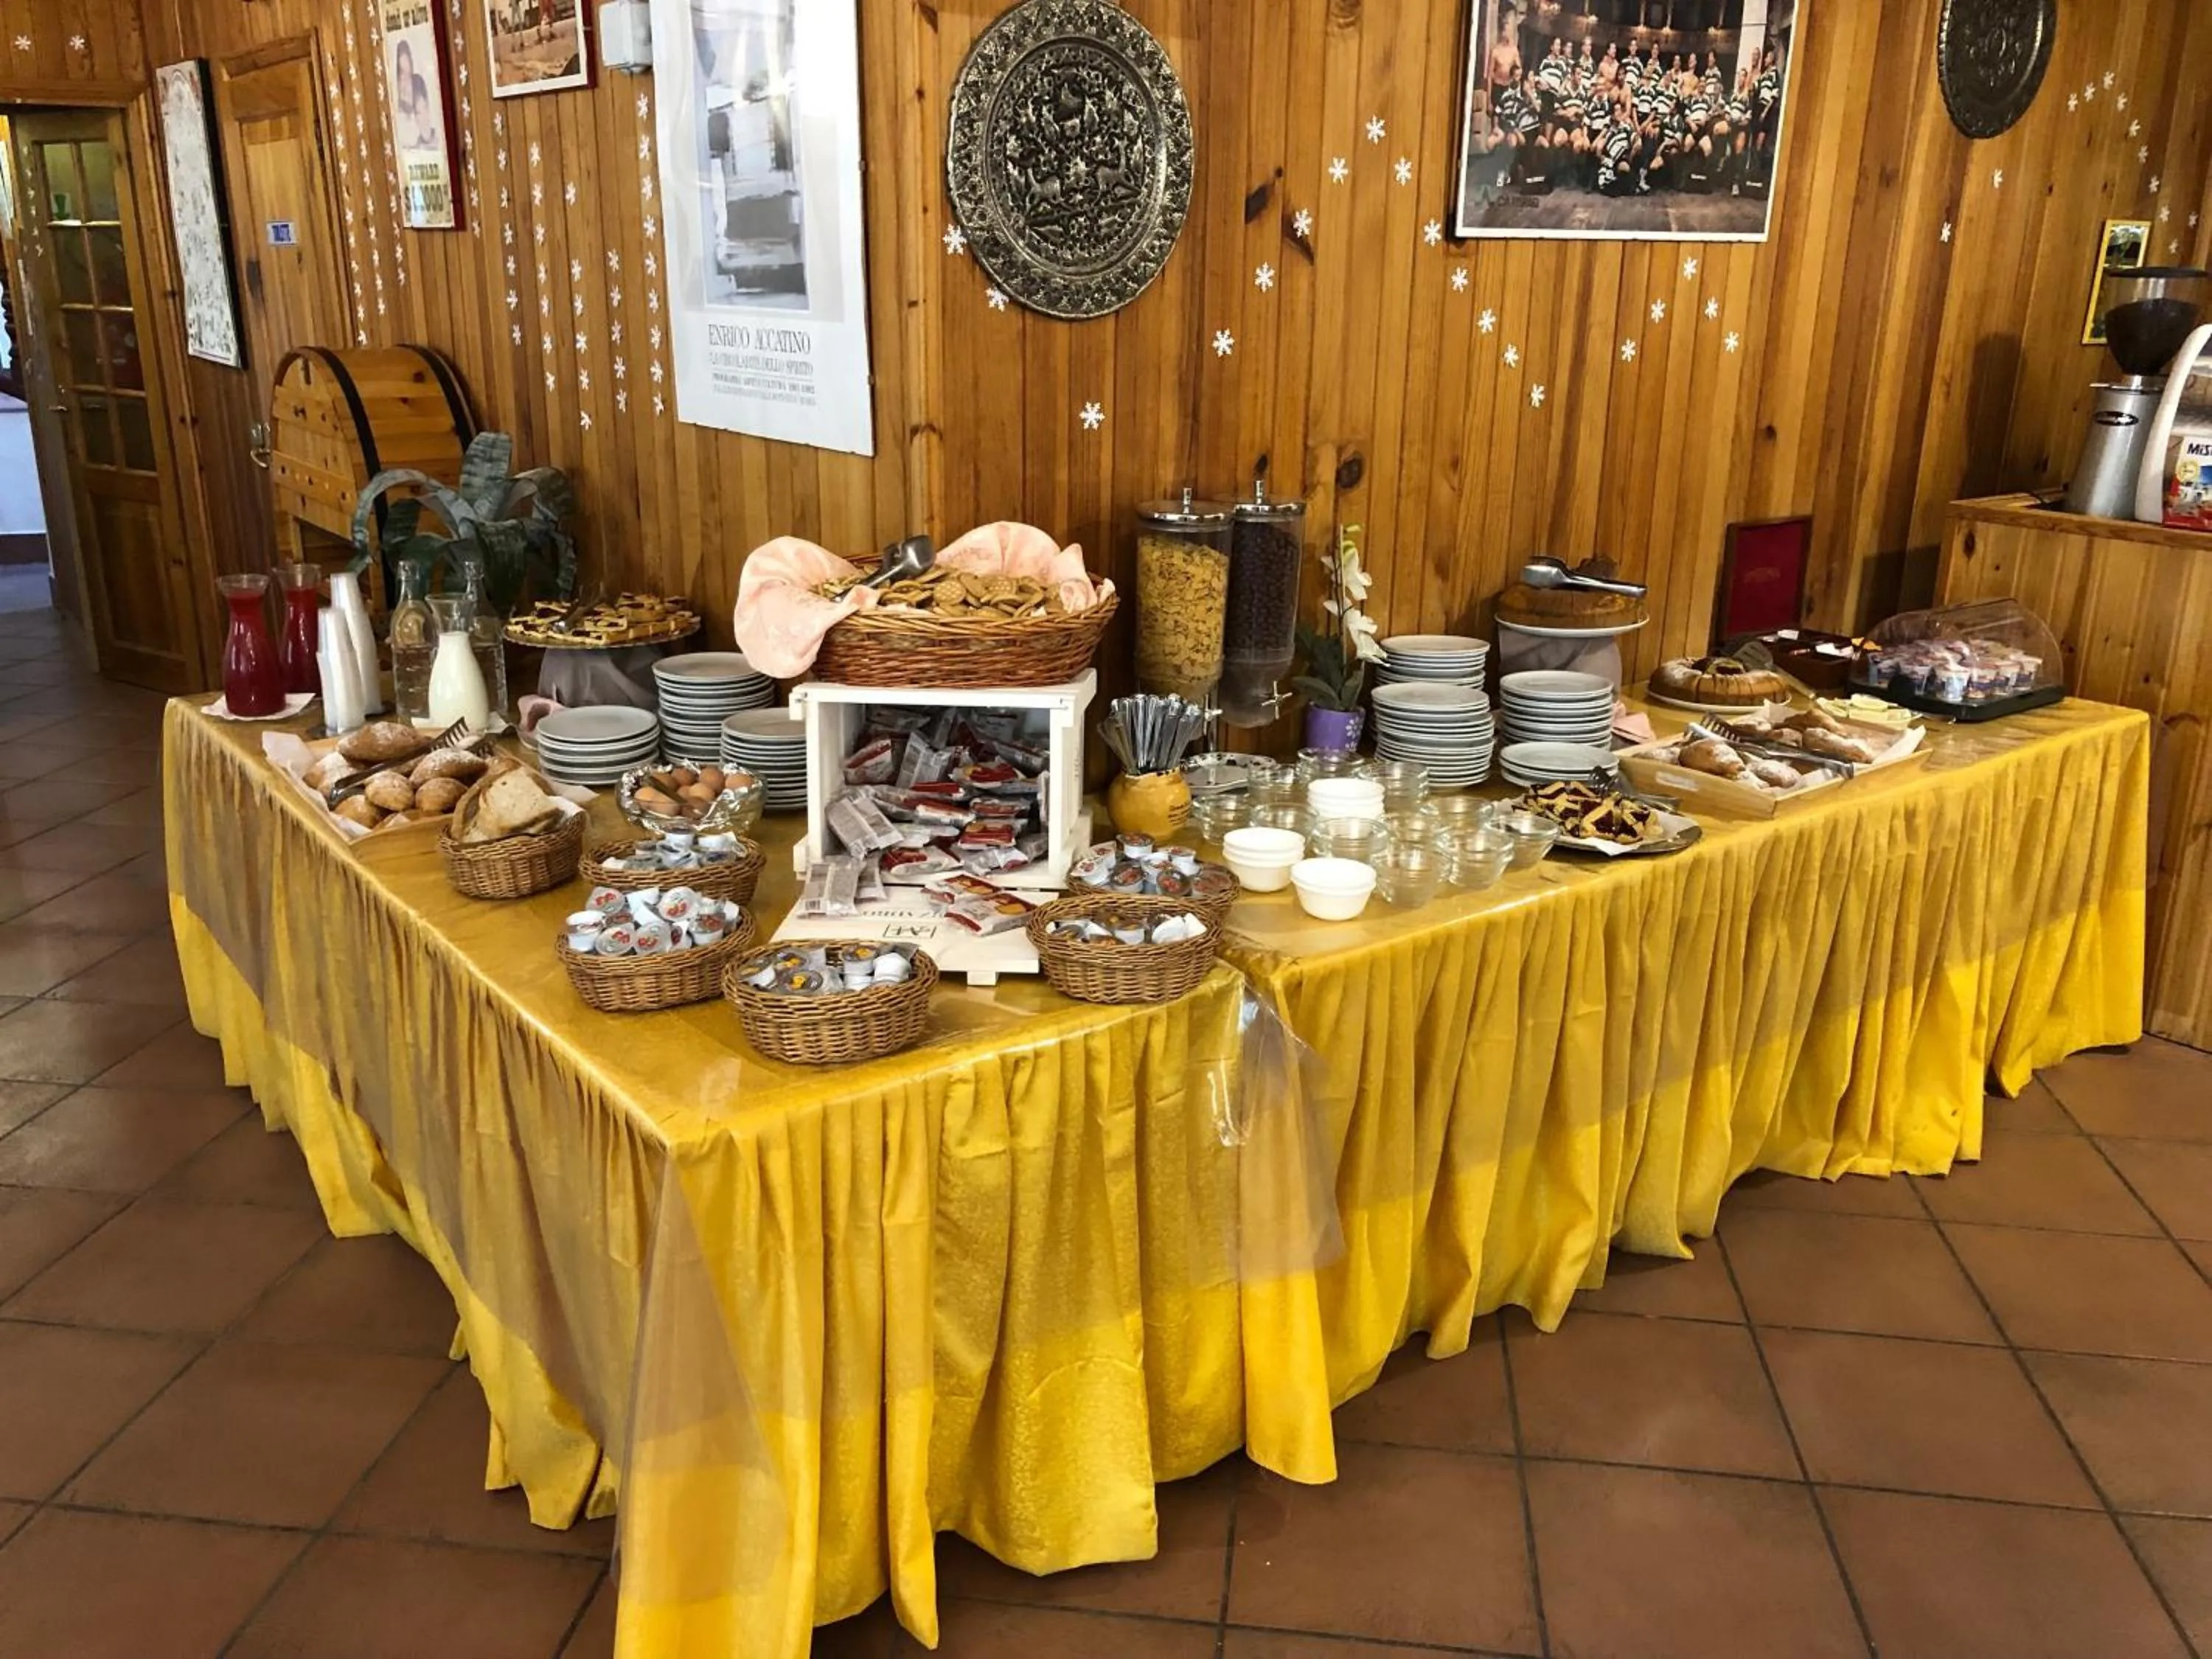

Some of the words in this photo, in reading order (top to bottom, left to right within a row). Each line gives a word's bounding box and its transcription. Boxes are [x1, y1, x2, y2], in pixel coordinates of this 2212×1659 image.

[709, 324, 750, 348] ENRICO
[754, 327, 810, 355] ACCATINO
[2187, 442, 2212, 456] MiS
